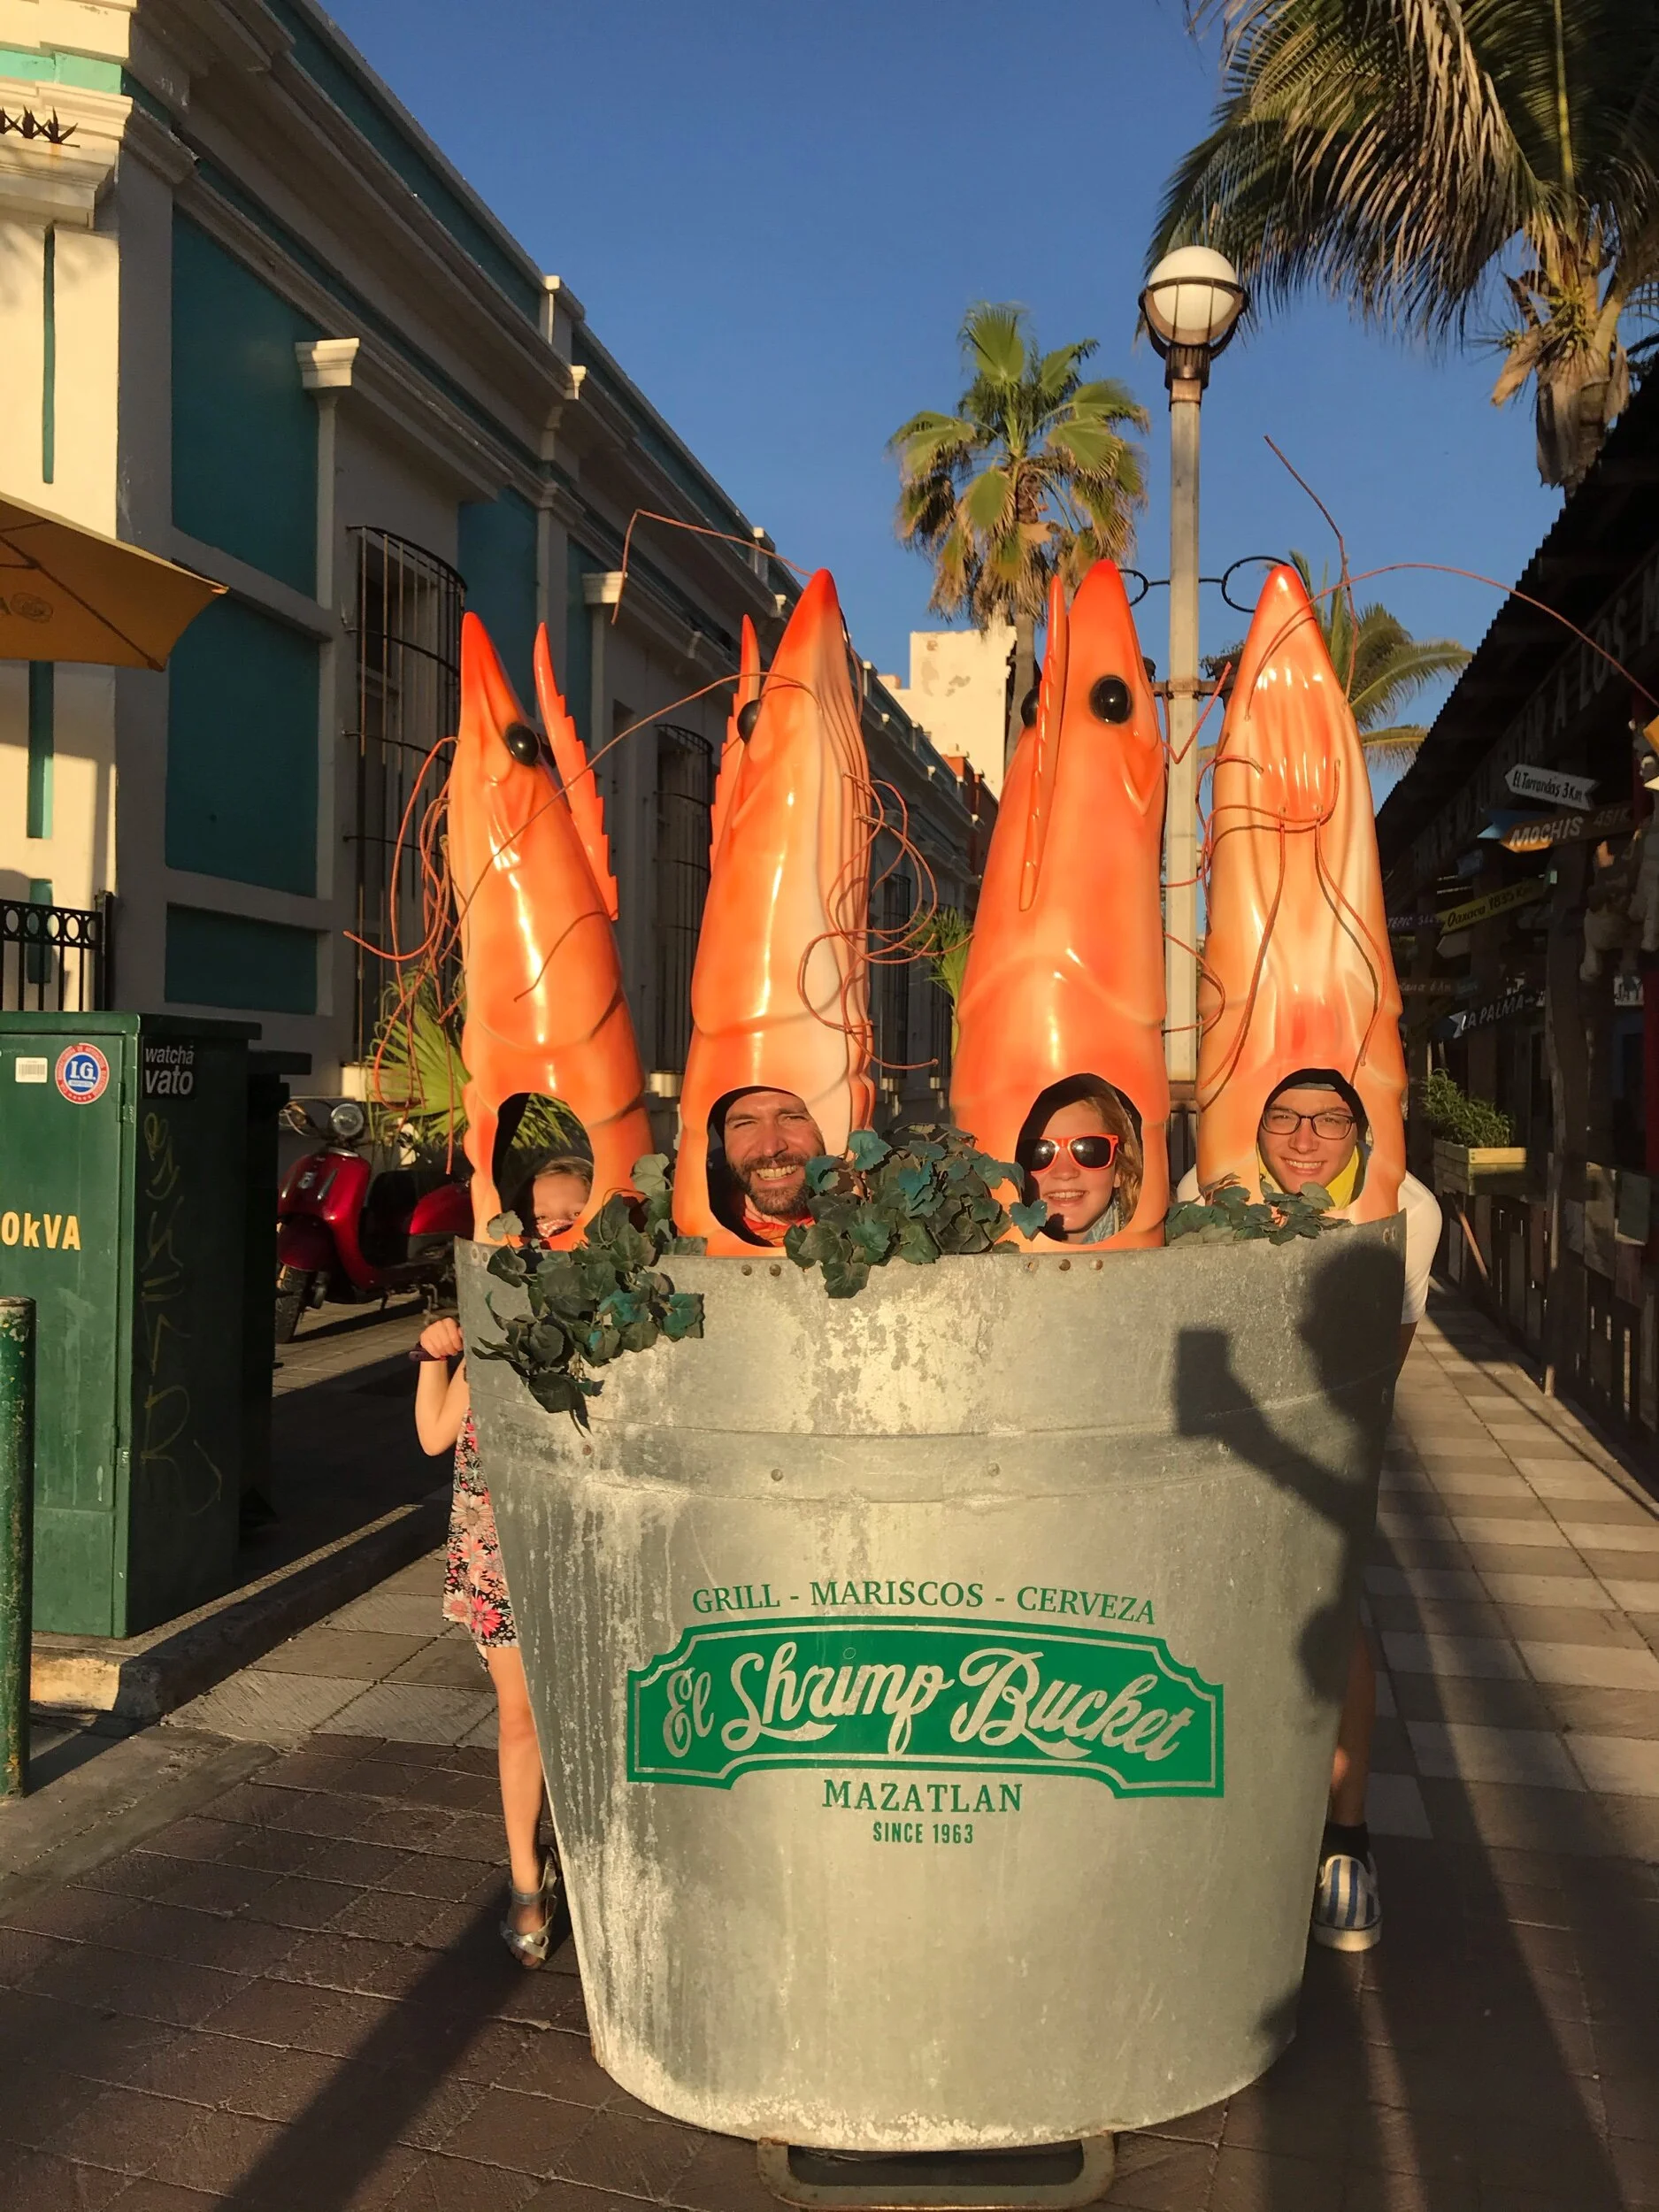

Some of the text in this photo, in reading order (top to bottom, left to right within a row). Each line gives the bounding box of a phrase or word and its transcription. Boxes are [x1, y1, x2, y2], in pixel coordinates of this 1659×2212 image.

[1509, 815, 1584, 847] MOCHIS
[1461, 994, 1525, 1031] LA PALMA
[144, 1064, 194, 1095] vato
[692, 1583, 780, 1613] GRILL
[810, 1580, 984, 1608] MARISCOS
[1017, 1586, 1156, 1625] CERVEZA
[663, 1641, 1195, 1762] El Shrimp Bucket
[822, 1778, 1023, 1813] MAZATLAN
[872, 1821, 974, 1845] SINCE 1963
